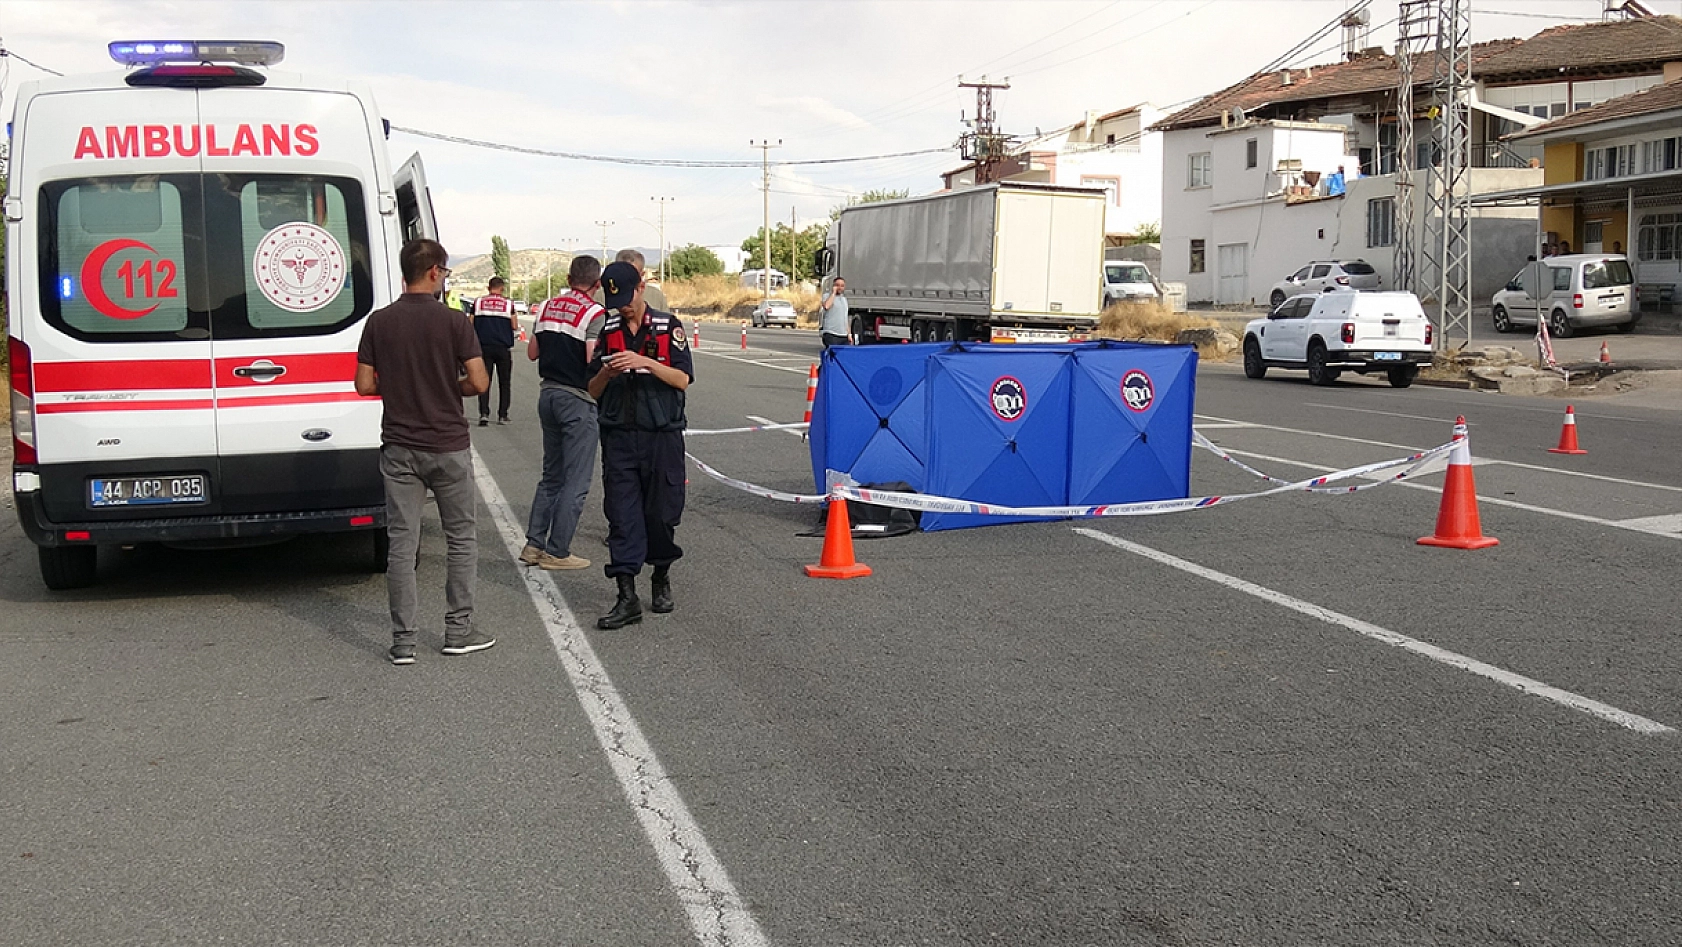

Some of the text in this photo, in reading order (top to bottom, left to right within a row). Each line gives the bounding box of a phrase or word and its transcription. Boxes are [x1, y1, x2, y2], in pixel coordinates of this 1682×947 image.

[74, 124, 319, 159] AMBULANS
[117, 259, 178, 298] 112
[97, 438, 121, 446] AWD
[103, 478, 200, 498] 44 ACP 035
